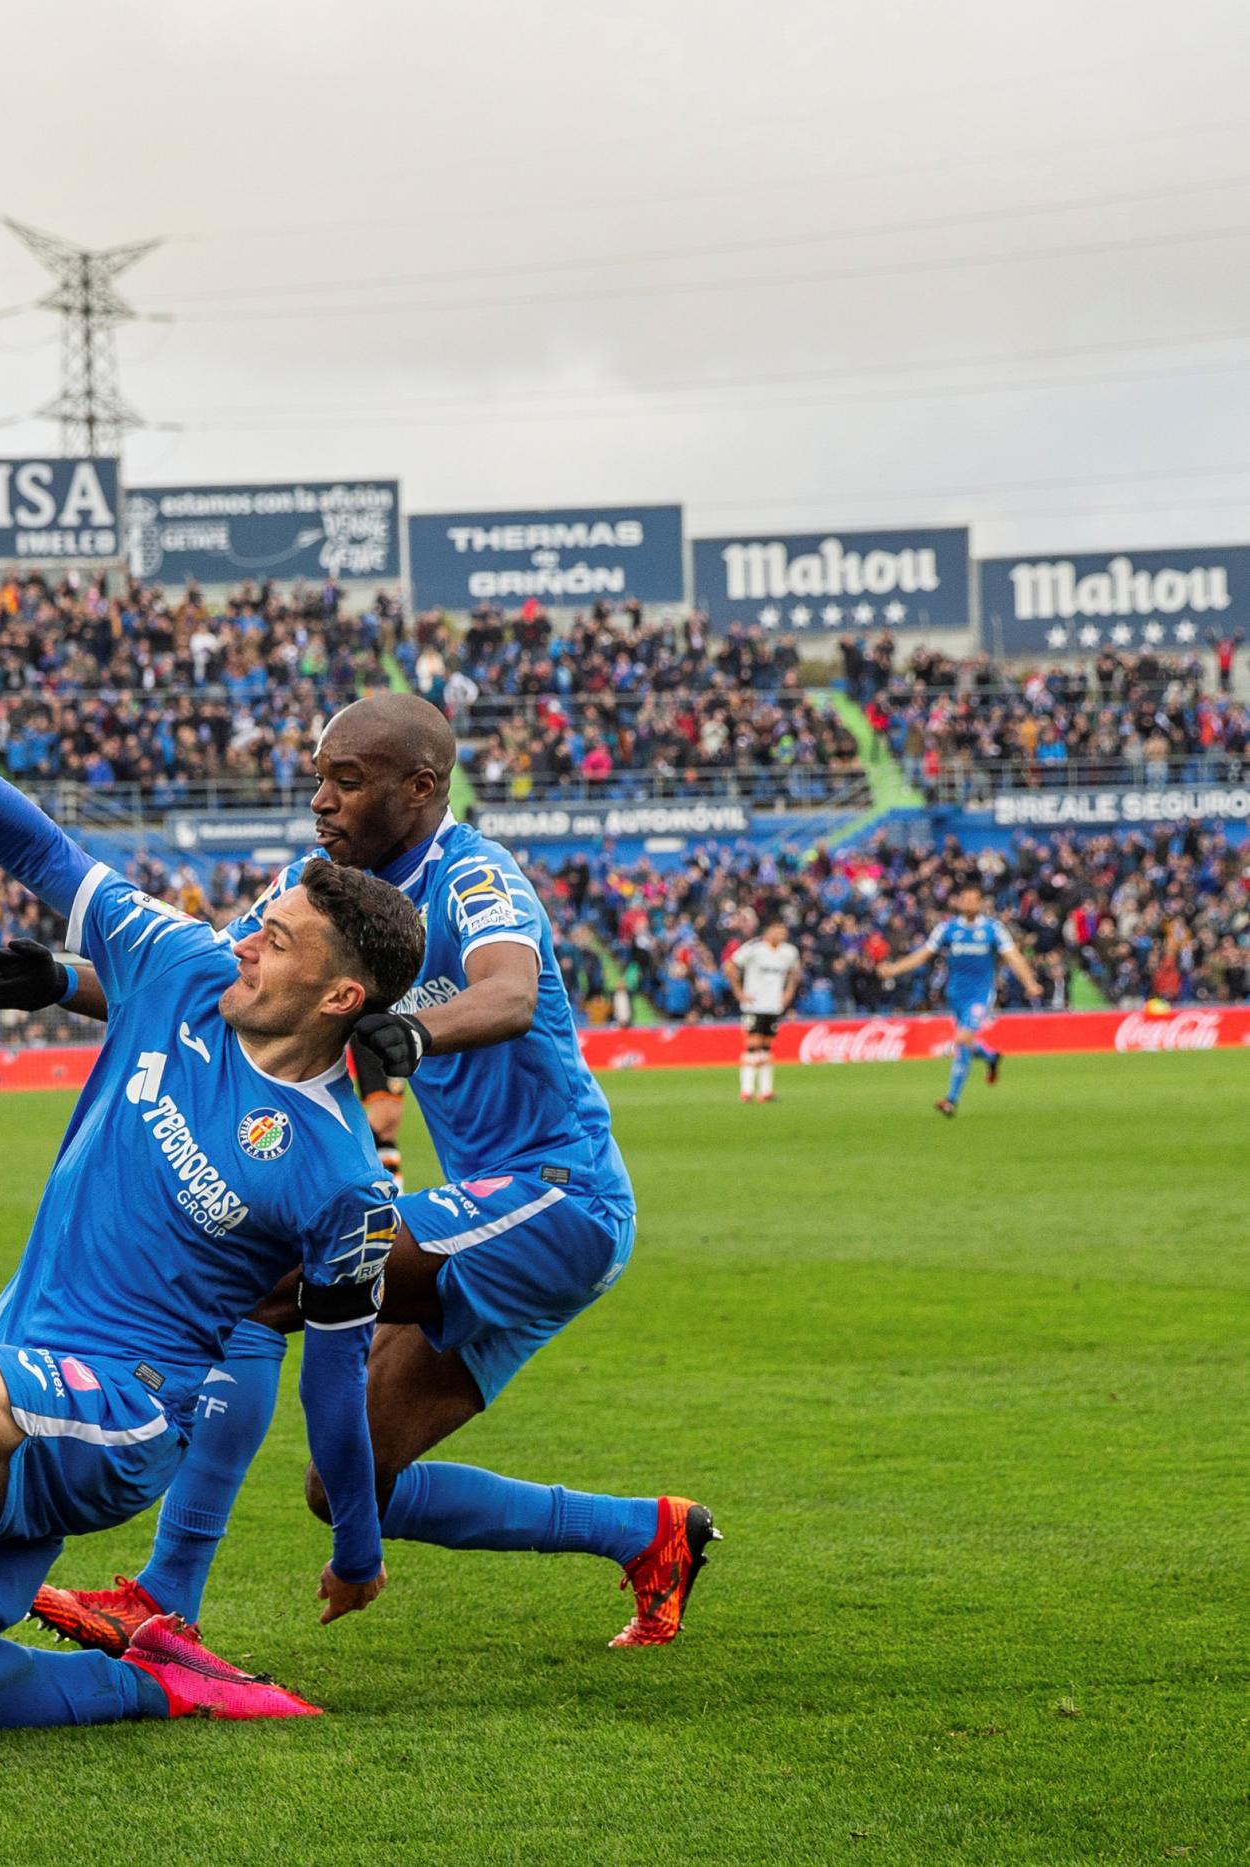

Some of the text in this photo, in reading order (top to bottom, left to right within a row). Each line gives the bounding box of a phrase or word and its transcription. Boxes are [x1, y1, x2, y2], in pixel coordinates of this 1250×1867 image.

[159, 491, 251, 518] estamos
[253, 491, 294, 516] con
[446, 520, 644, 553] THERMAS
[468, 562, 626, 597] GRIÑÓN
[721, 536, 941, 600] Mahou
[1010, 555, 1233, 621] Mahou
[479, 811, 570, 837] CIUDAD
[1017, 793, 1120, 823] REALE
[176, 1189, 227, 1238] GROUP
